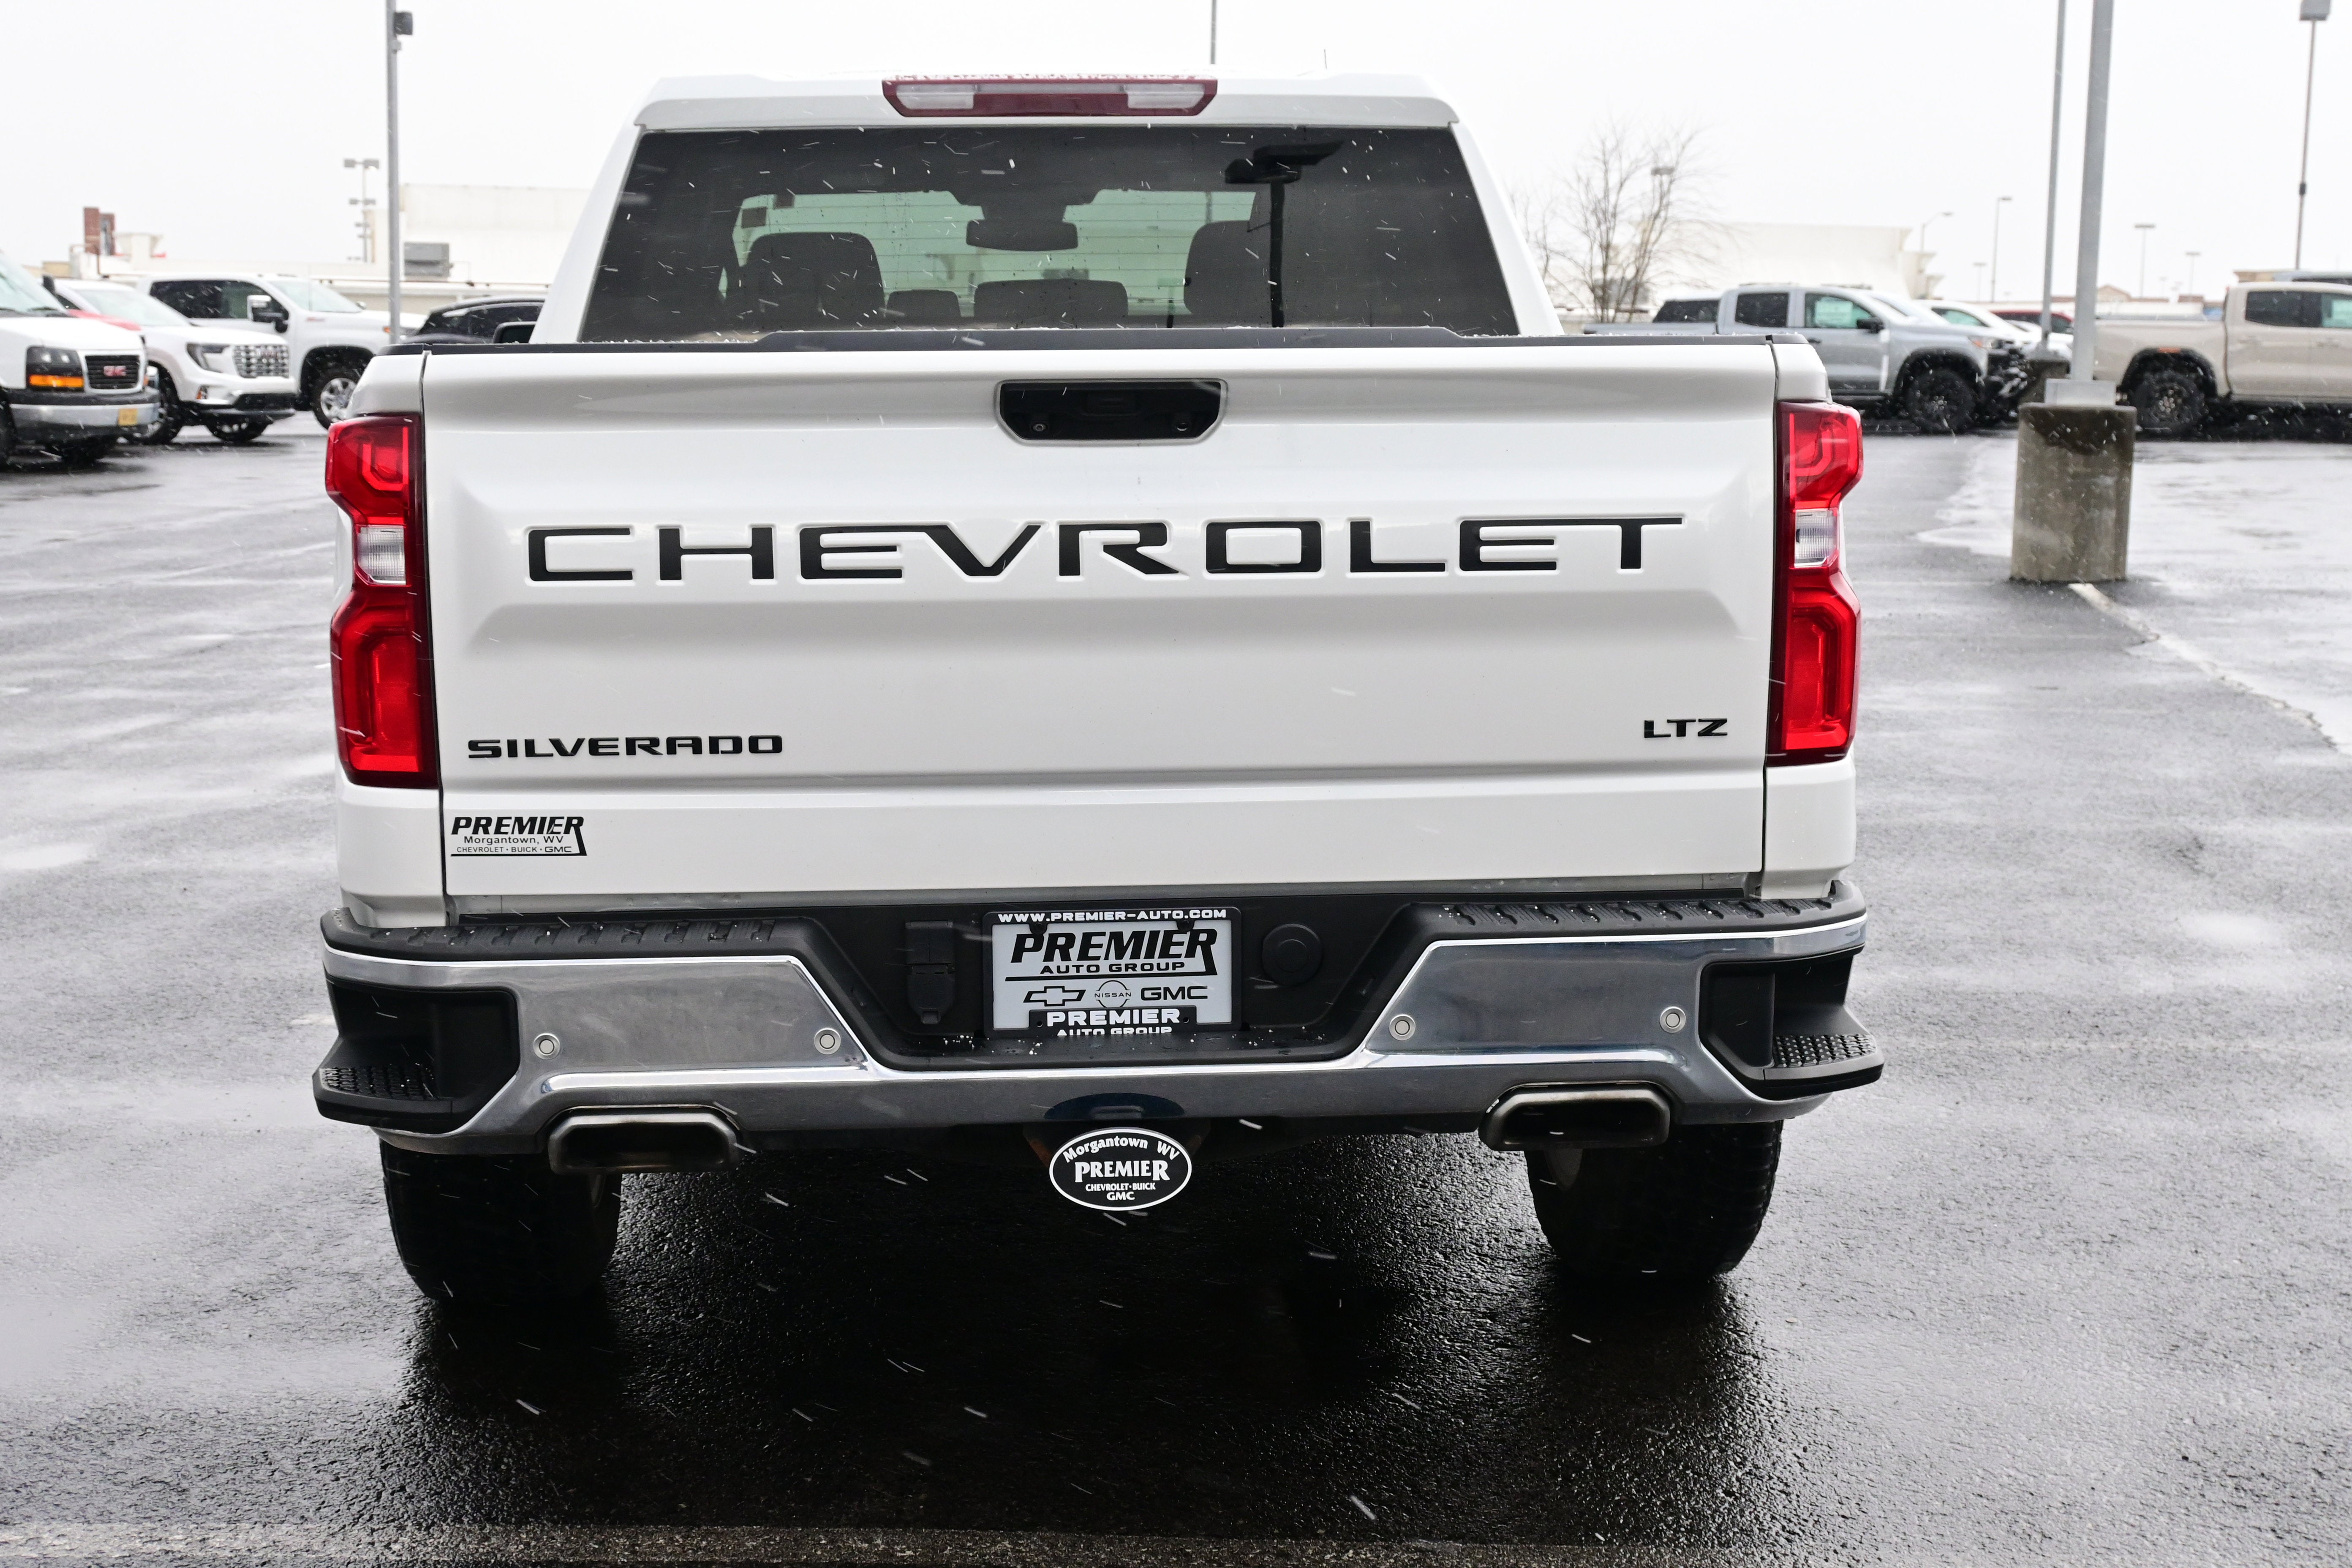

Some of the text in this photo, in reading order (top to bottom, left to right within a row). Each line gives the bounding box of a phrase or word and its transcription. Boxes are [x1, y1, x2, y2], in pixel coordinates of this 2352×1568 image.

[528, 517, 1682, 582] CHEVROLET
[1644, 718, 1728, 738] LTZ
[468, 735, 783, 759] SILVERADO
[451, 816, 585, 835] PREMIER
[464, 836, 539, 846] Morgantown,
[998, 909, 1227, 923] WWW.PREMIER-AUTO.COM
[1010, 928, 1217, 964] PREMIER
[1040, 961, 1185, 974] AUTO GROUP
[1141, 985, 1208, 1001] GMC
[1047, 1008, 1180, 1027] PREMIER
[1057, 1026, 1172, 1036] AUTO GROUP
[1062, 1135, 1180, 1163] Morgantown WV
[1074, 1160, 1170, 1183] PREMIER
[1085, 1182, 1156, 1192] CHEVROLET BUICK
[1106, 1191, 1135, 1200] GMC
